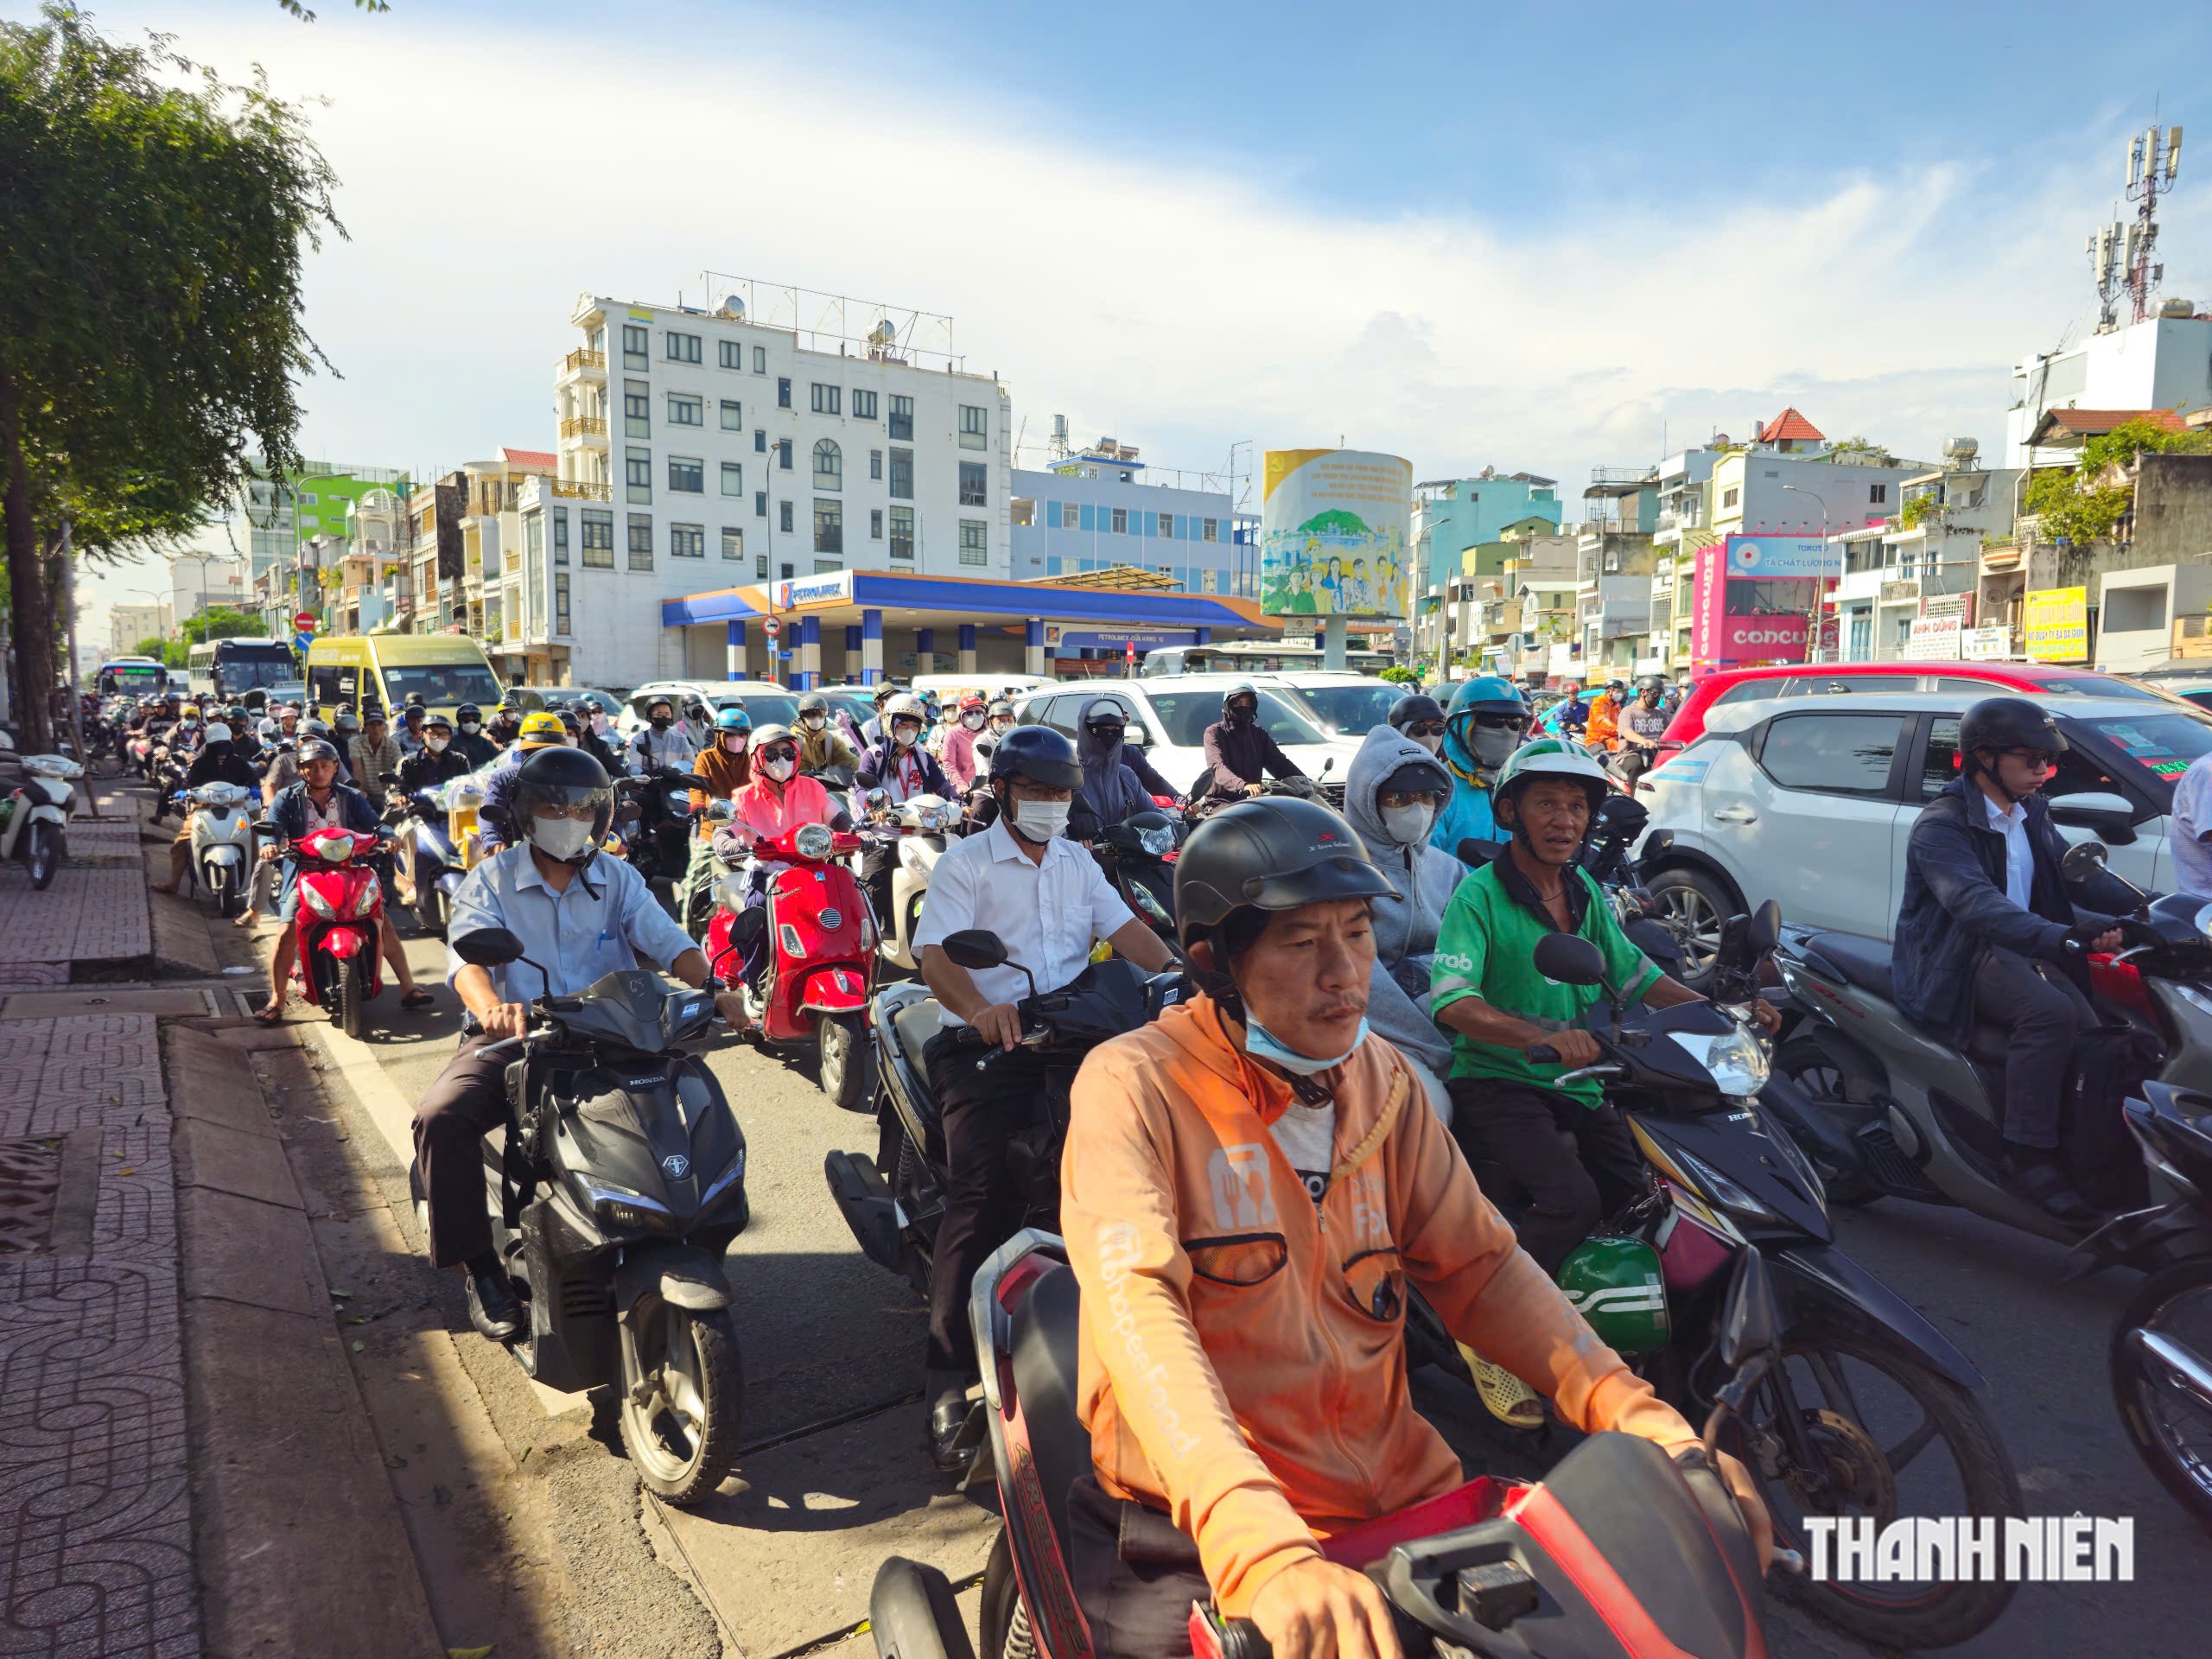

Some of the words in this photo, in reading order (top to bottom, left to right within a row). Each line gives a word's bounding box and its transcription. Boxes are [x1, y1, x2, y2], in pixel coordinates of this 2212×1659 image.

[1913, 622, 1930, 635] ANH
[1733, 629, 1839, 649] concug
[537, 718, 553, 728] be
[629, 1076, 666, 1086] HONDA
